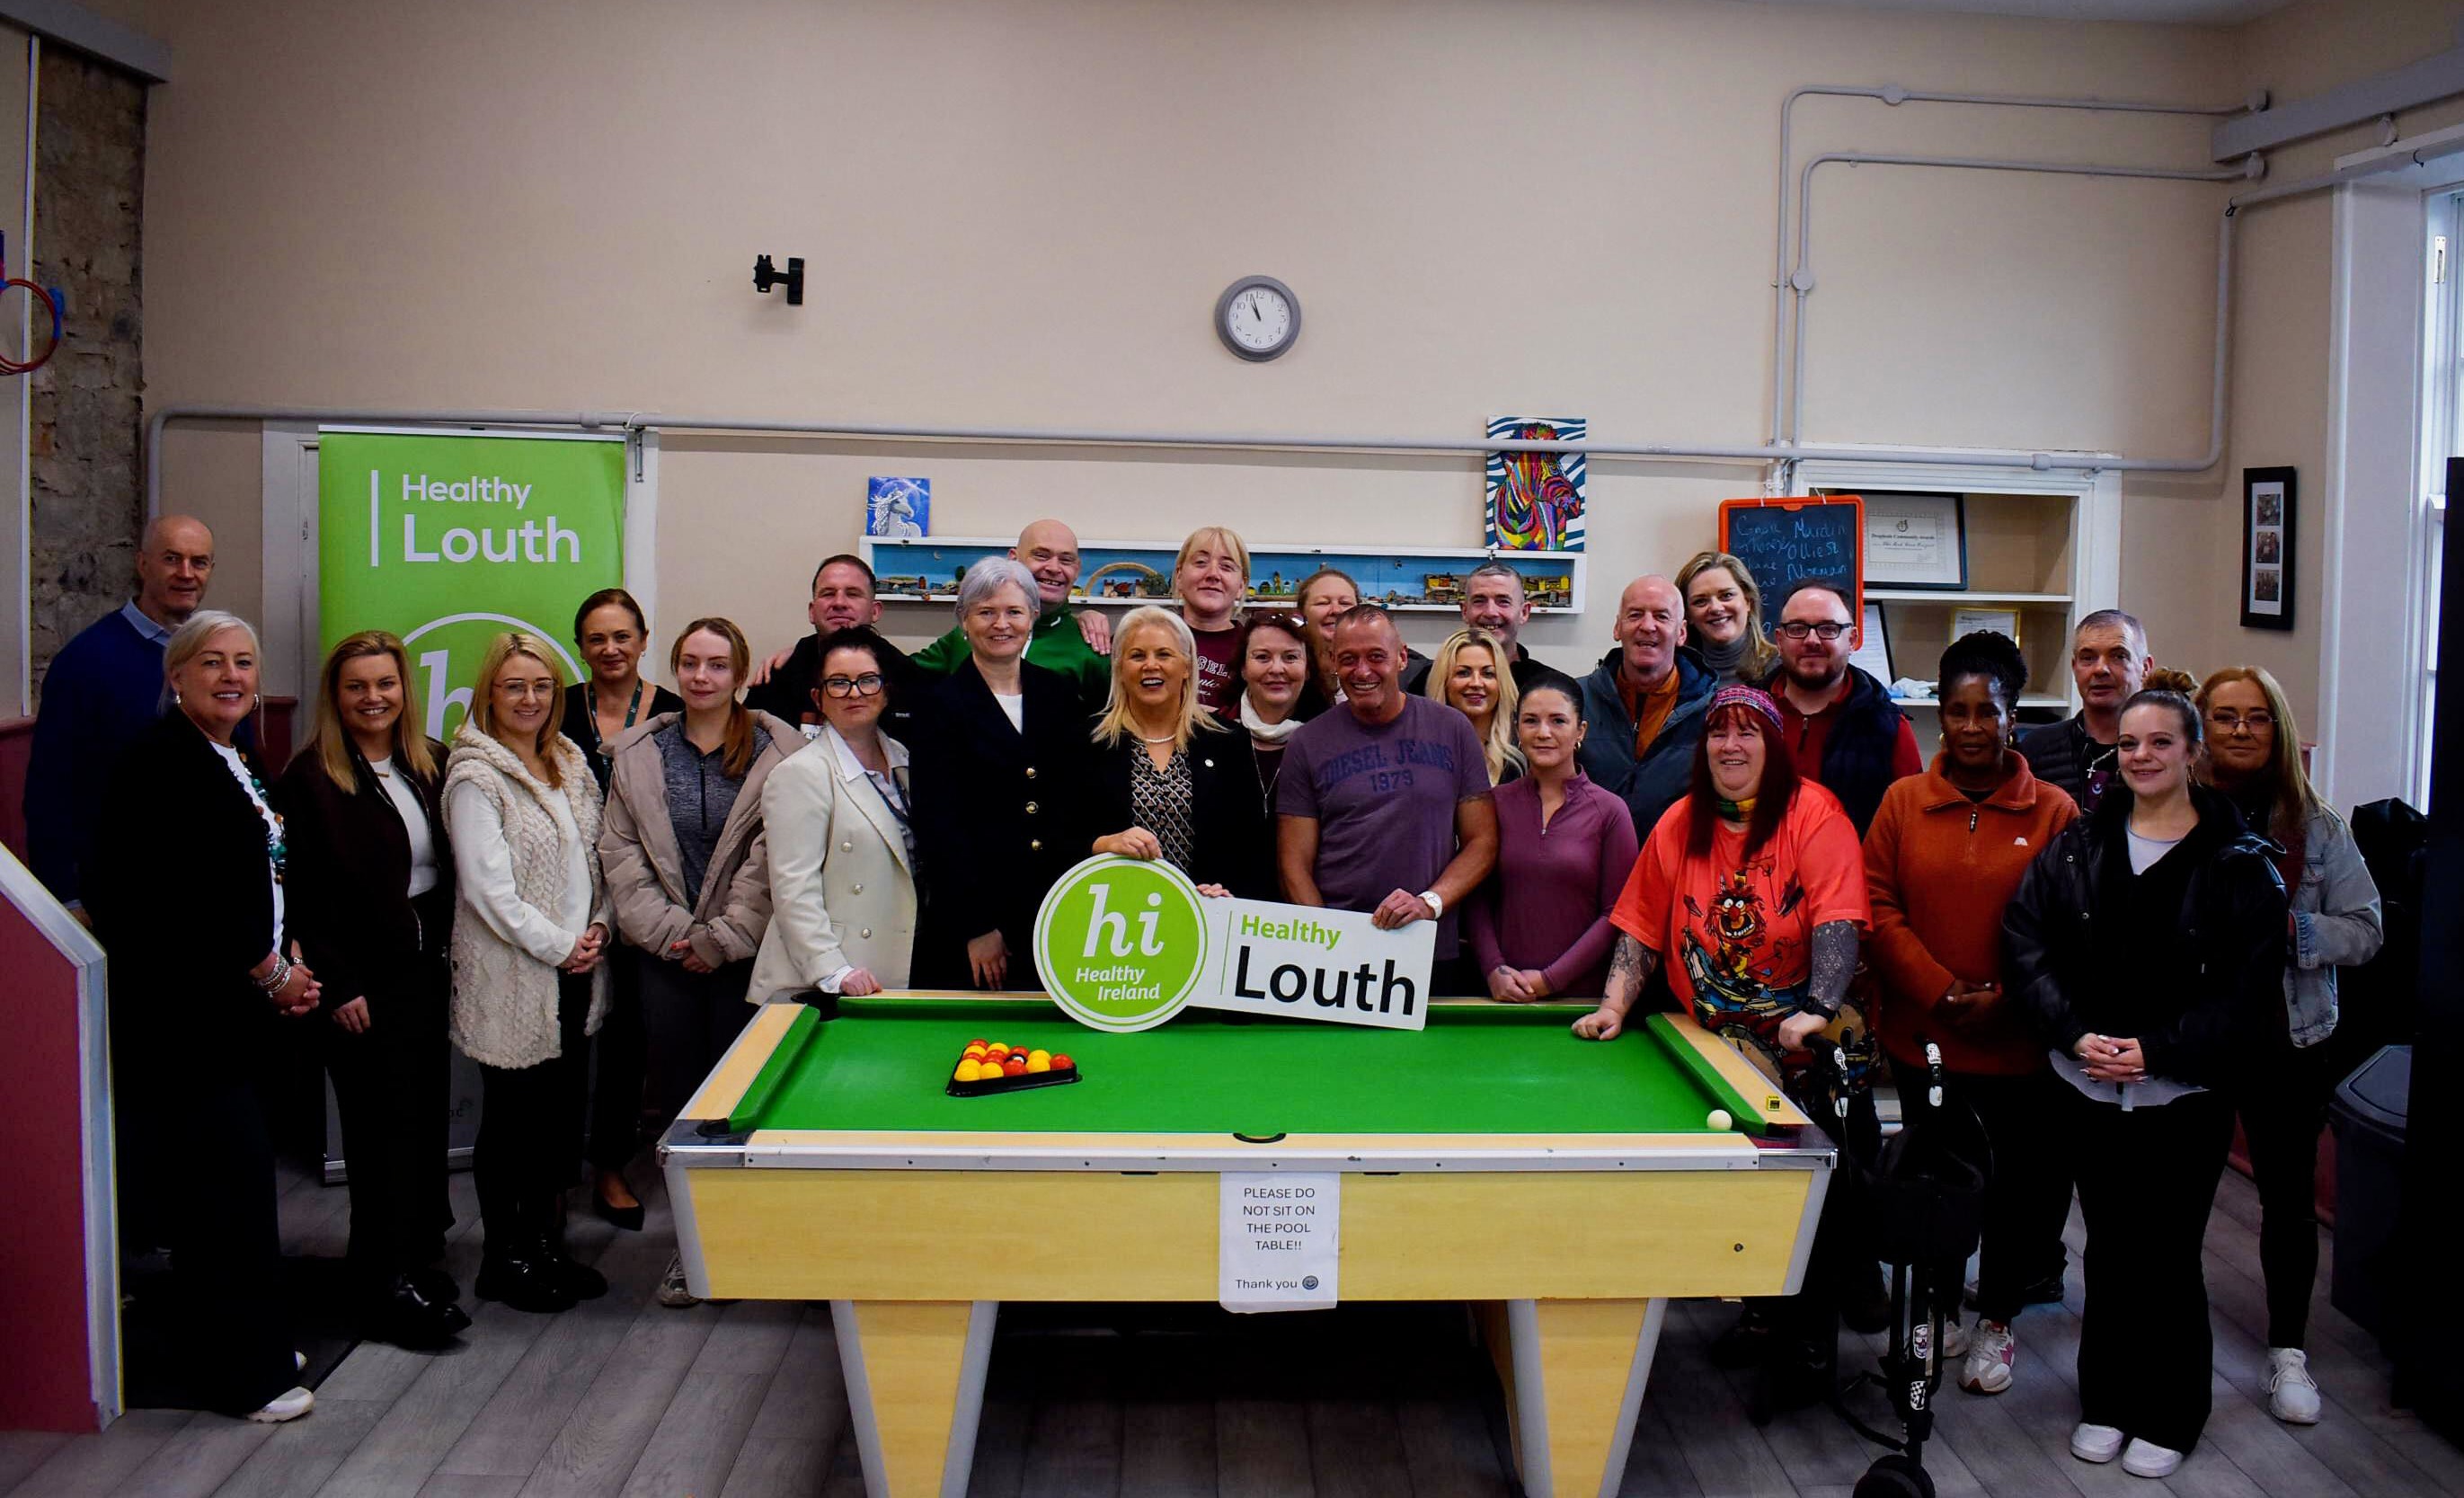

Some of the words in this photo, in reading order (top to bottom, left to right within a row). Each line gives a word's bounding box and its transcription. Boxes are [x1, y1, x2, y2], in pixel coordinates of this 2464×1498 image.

[403, 474, 532, 510] Healthy
[404, 513, 581, 563] Louth
[1082, 883, 1165, 958] hi
[1241, 914, 1342, 951] Healthy
[1076, 965, 1146, 985] Healthy
[1235, 944, 1415, 1015] Louth
[1097, 982, 1160, 1001] Ireland
[1244, 1187, 1291, 1198] PLEASE
[1295, 1188, 1315, 1198] DO
[1243, 1206, 1270, 1216] NOT
[1272, 1206, 1291, 1216] SIT
[1295, 1206, 1315, 1215] ON
[1246, 1223, 1271, 1233] THE
[1275, 1223, 1311, 1233] POOL
[1255, 1240, 1302, 1251] TABLE!!
[1236, 1279, 1273, 1289] Thank
[1276, 1282, 1298, 1290] you
